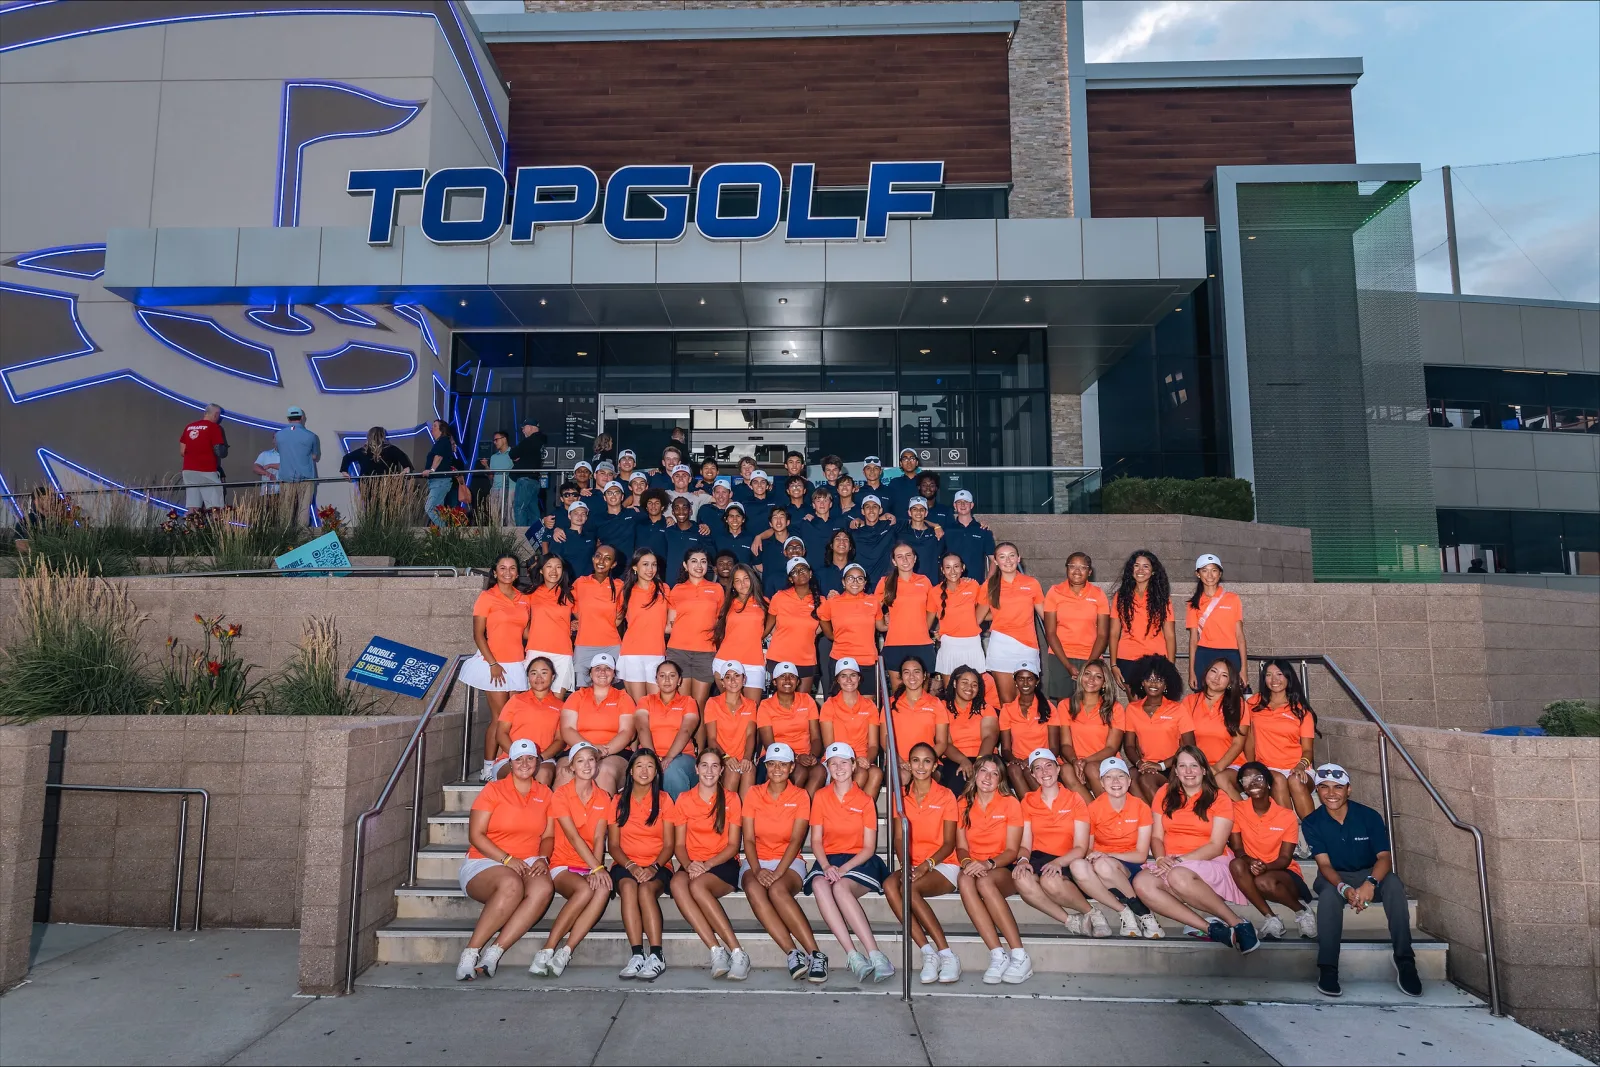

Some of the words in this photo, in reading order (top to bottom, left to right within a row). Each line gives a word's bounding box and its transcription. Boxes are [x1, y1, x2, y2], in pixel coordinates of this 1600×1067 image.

[346, 161, 945, 245] TOPGOLF
[367, 645, 396, 660] MOBILE
[355, 660, 364, 669] IS
[365, 663, 384, 675] HERE.
[361, 653, 398, 669] ORDERING
